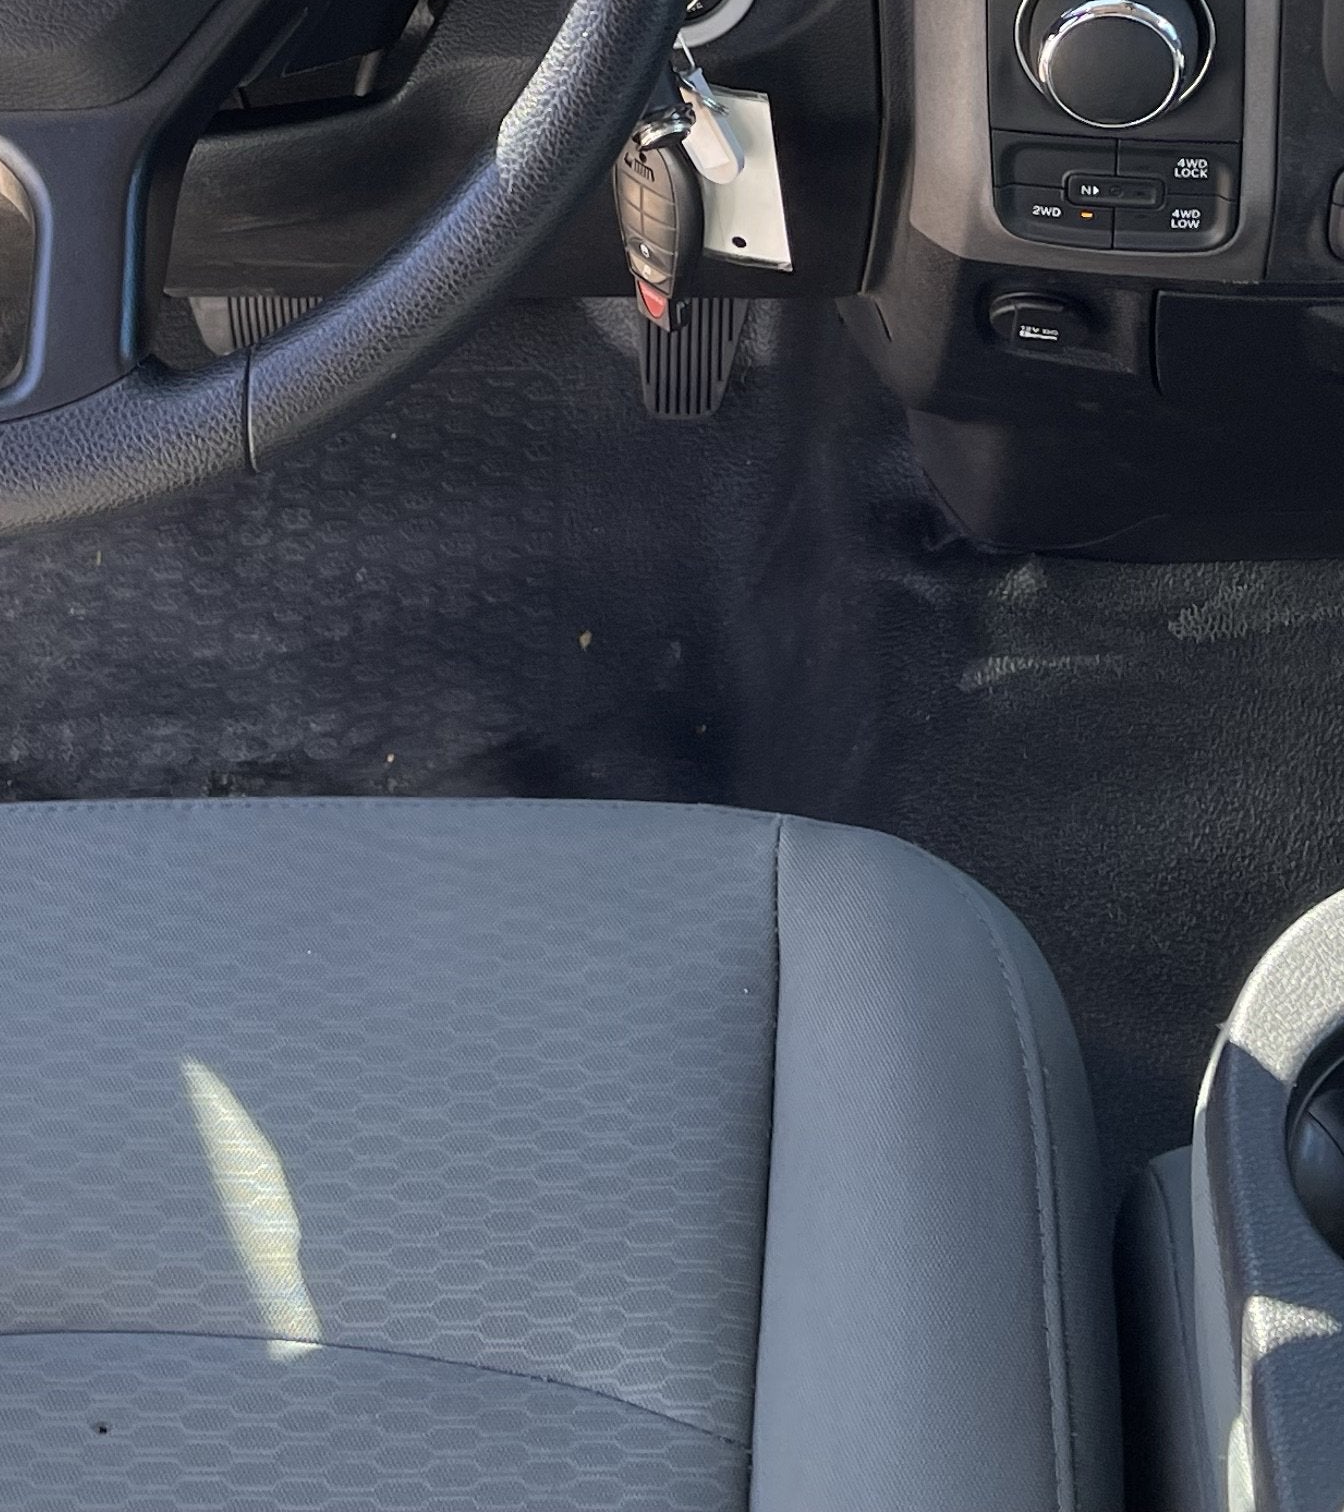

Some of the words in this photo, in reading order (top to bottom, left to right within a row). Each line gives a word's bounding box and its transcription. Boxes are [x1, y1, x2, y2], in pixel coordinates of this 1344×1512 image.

[1177, 158, 1208, 169] 4WD
[1174, 168, 1208, 179] LOCK
[1081, 185, 1092, 196] N
[1032, 205, 1062, 218] 2WD
[1172, 209, 1201, 219] 4WD
[1171, 219, 1200, 229] LOW
